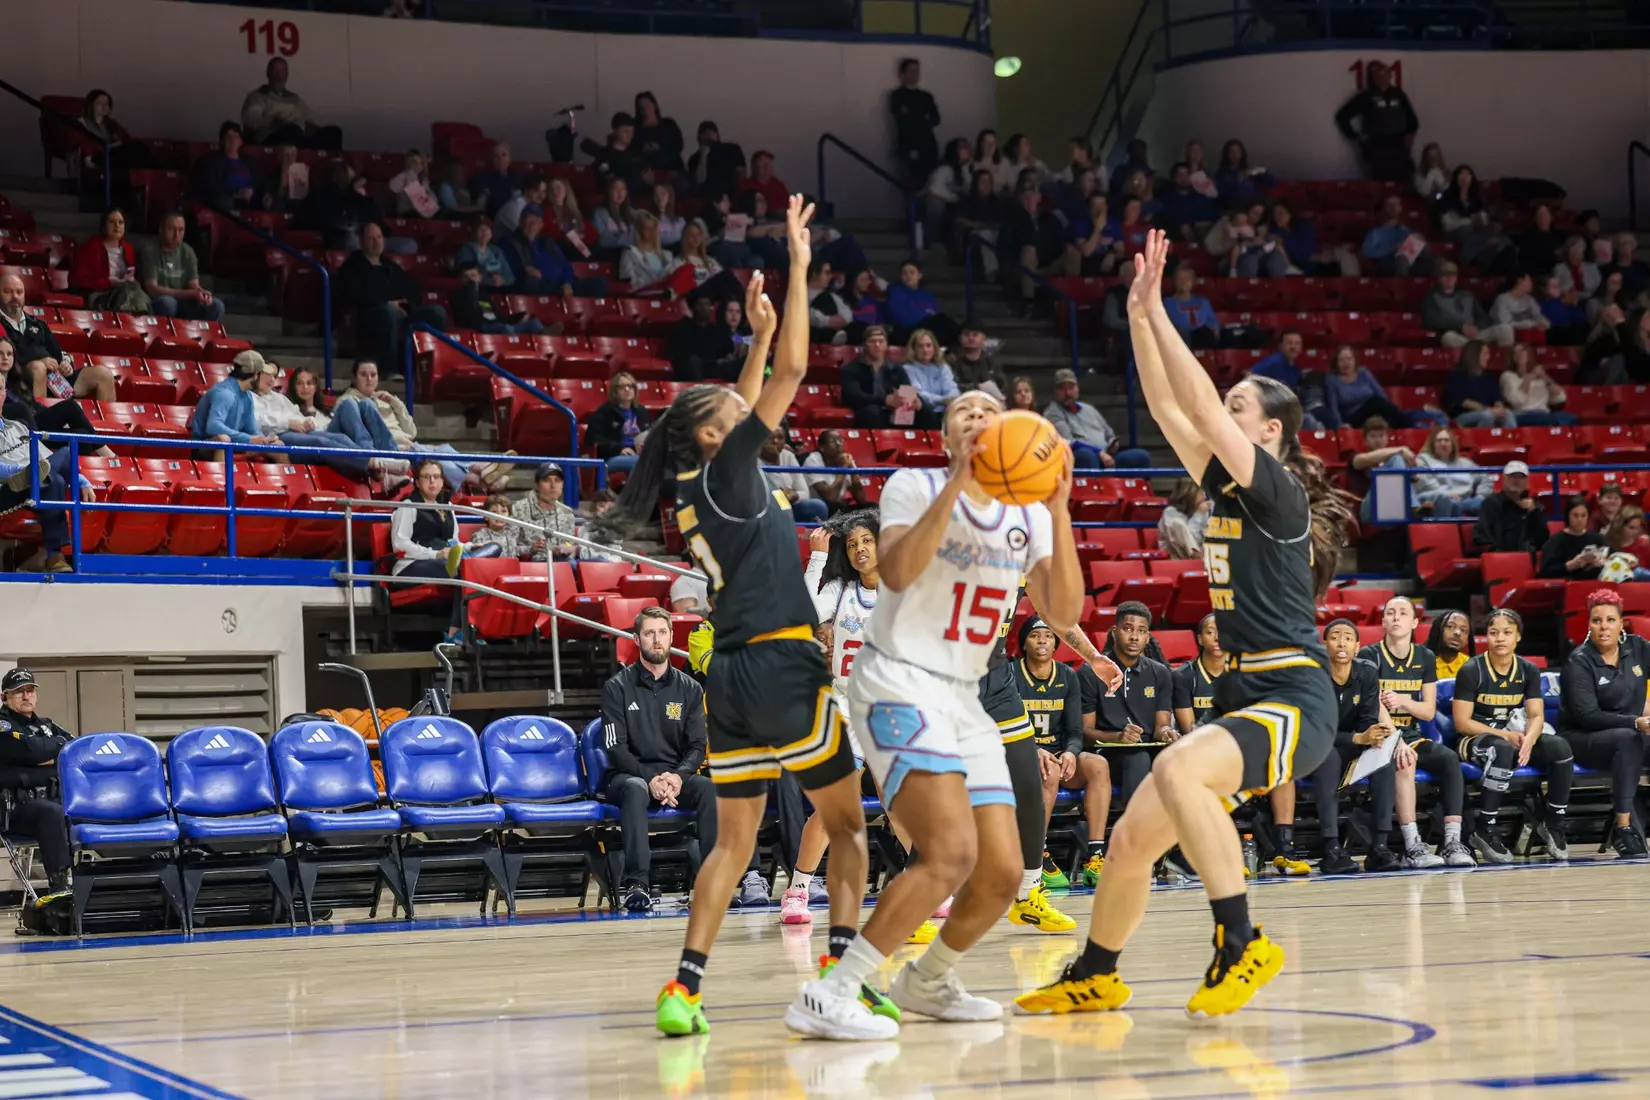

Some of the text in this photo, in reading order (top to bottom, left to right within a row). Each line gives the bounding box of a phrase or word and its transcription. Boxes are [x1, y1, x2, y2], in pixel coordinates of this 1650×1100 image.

[239, 18, 300, 57] 119
[1348, 59, 1402, 92] 11
[943, 581, 1008, 645] 15
[1477, 693, 1525, 706] KENNESAW
[1033, 713, 1051, 736] 4
